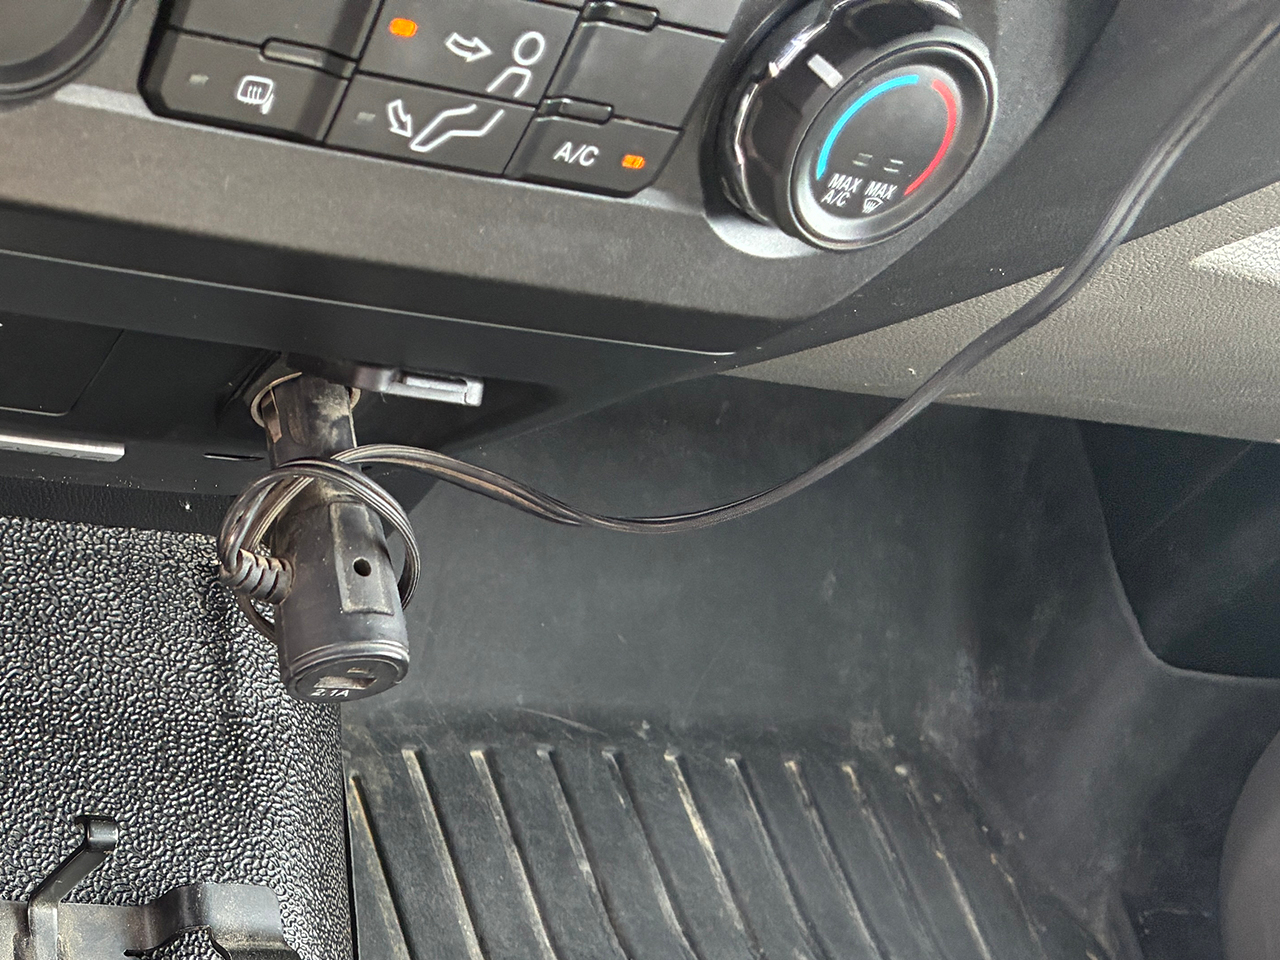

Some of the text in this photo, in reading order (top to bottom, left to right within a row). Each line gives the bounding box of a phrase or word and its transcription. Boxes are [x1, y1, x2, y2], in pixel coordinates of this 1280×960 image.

[553, 141, 600, 167] A/C
[827, 172, 863, 193] MAX
[864, 180, 898, 200] MAX
[820, 188, 852, 207] A/C
[310, 688, 350, 697] 2.1A
